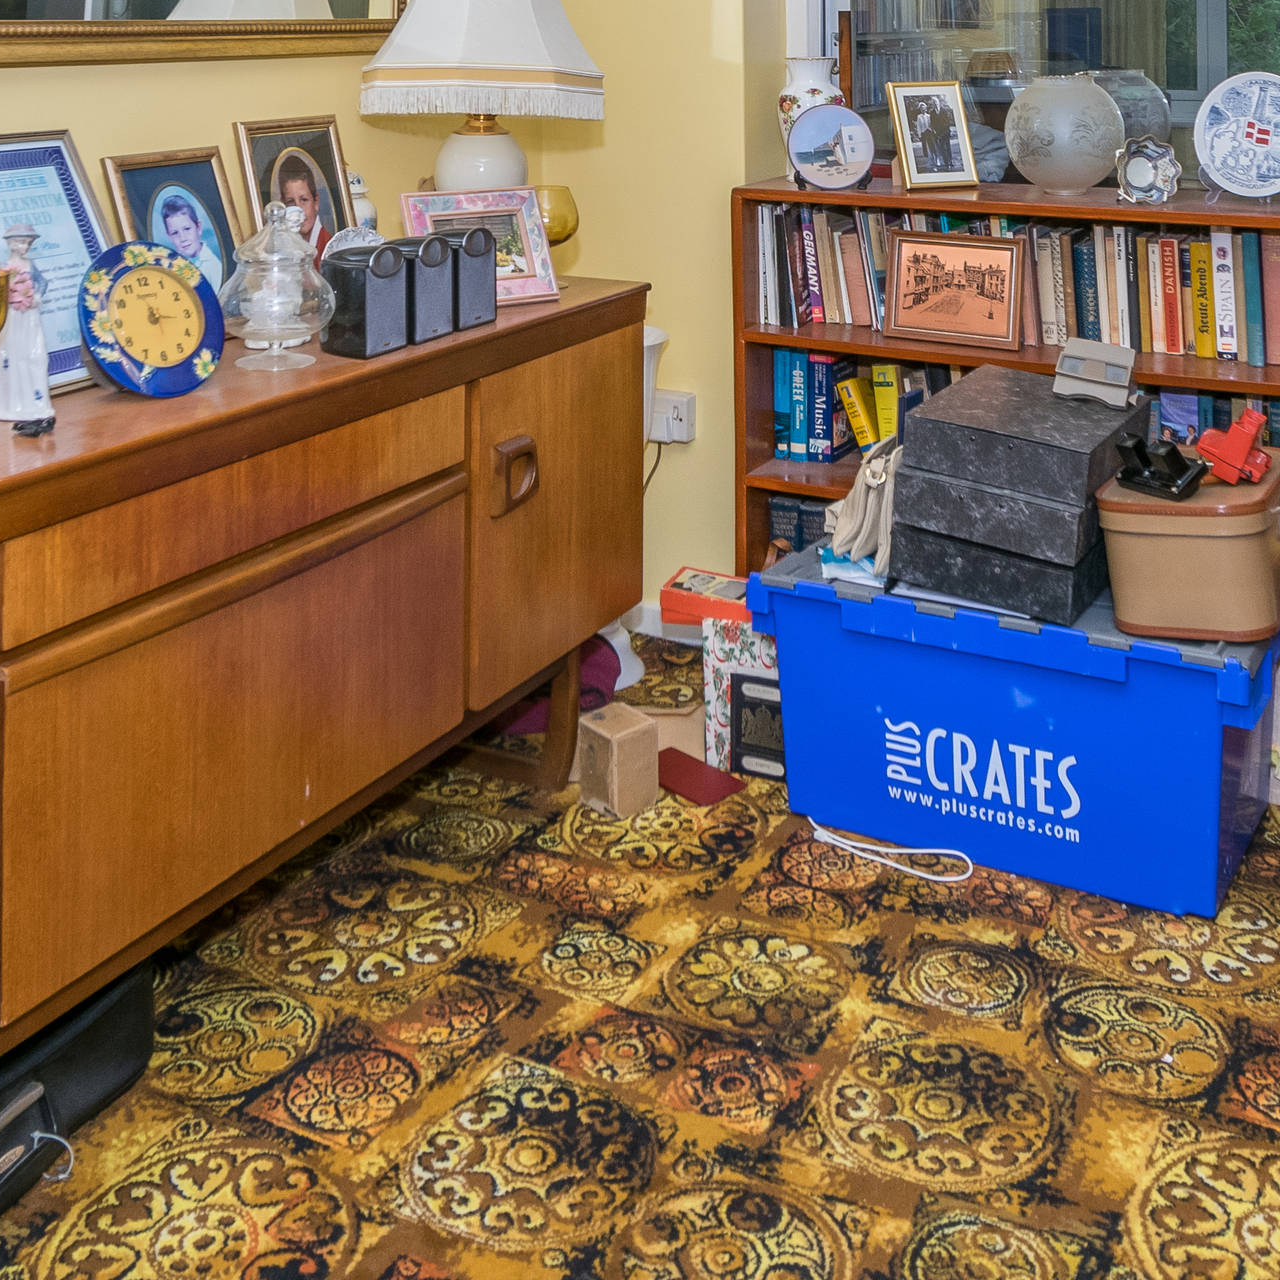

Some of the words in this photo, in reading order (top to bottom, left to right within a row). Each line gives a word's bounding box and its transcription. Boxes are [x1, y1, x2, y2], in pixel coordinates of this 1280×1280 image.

[2, 212, 53, 228] AWARD
[803, 230, 820, 295] GERMANY
[1163, 247, 1175, 294] DANISH
[123, 284, 133, 294] 11
[136, 277, 150, 287] 12
[158, 280, 165, 290] 1
[1197, 268, 1208, 301] Abend
[172, 291, 181, 301] 2
[1217, 279, 1233, 322] SPAIN
[183, 309, 191, 319] 3
[1198, 303, 1210, 334] Heute
[184, 328, 191, 337] 4
[125, 336, 133, 347] 8
[176, 343, 184, 353] 5
[142, 349, 149, 360] 7
[160, 351, 168, 361] 6
[792, 370, 804, 401] GREEK
[815, 395, 826, 438] Music
[884, 717, 922, 785] PLUS
[925, 727, 1081, 820] CRATES
[887, 785, 1080, 844] www.pluscrates.com
